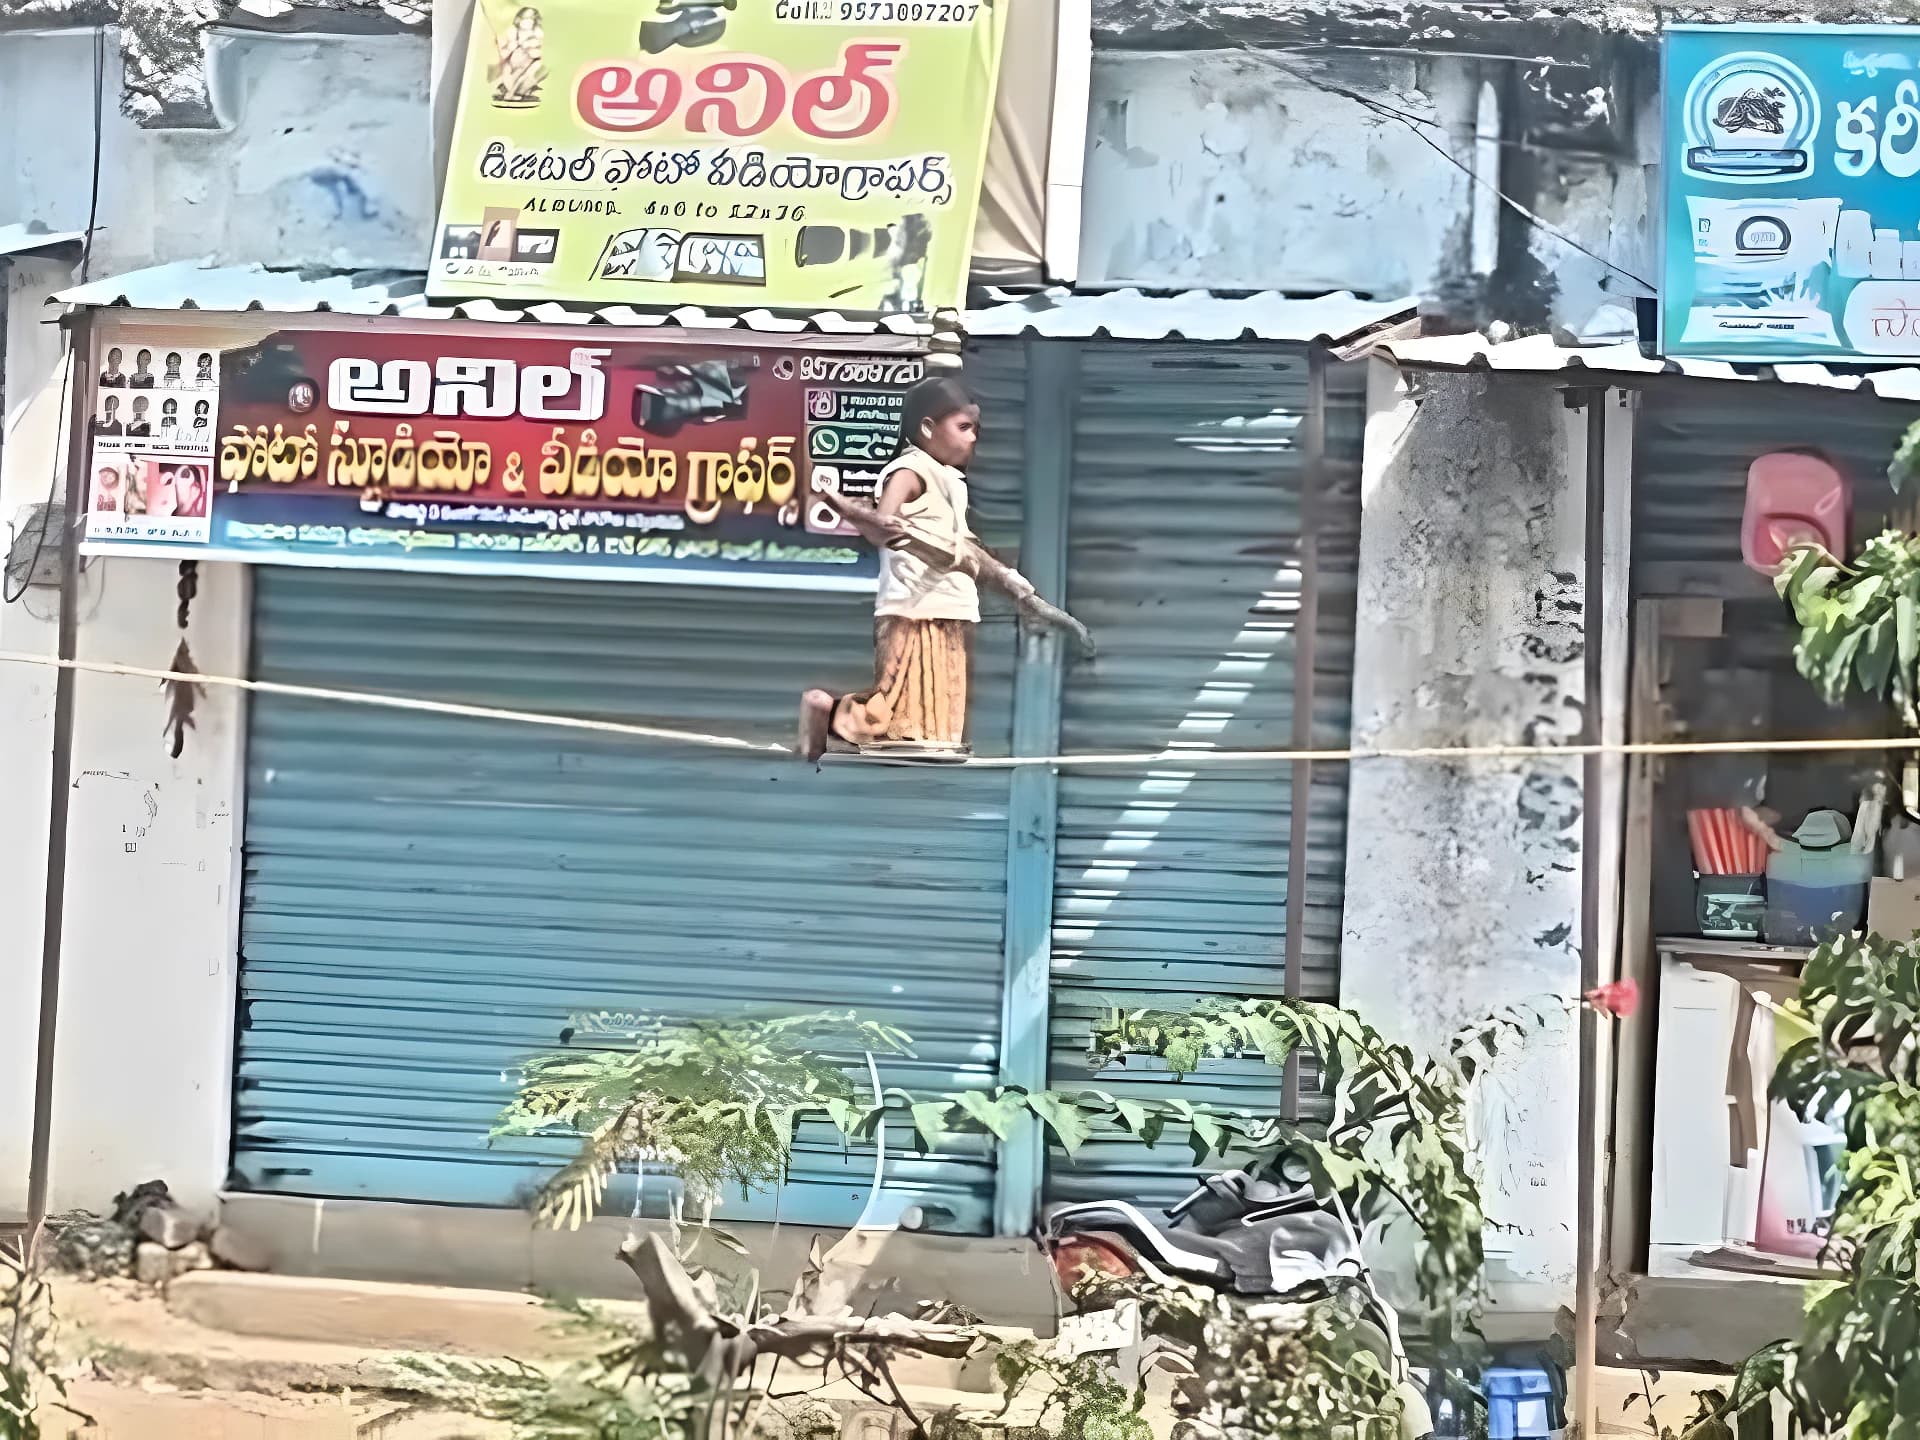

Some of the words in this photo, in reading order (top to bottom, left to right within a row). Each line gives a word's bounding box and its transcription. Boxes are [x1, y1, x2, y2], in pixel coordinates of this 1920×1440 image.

[577, 44, 901, 139] అనిల్
[328, 347, 611, 420] అనిల్
[220, 424, 318, 493] ఫోటో
[502, 451, 526, 493] &
